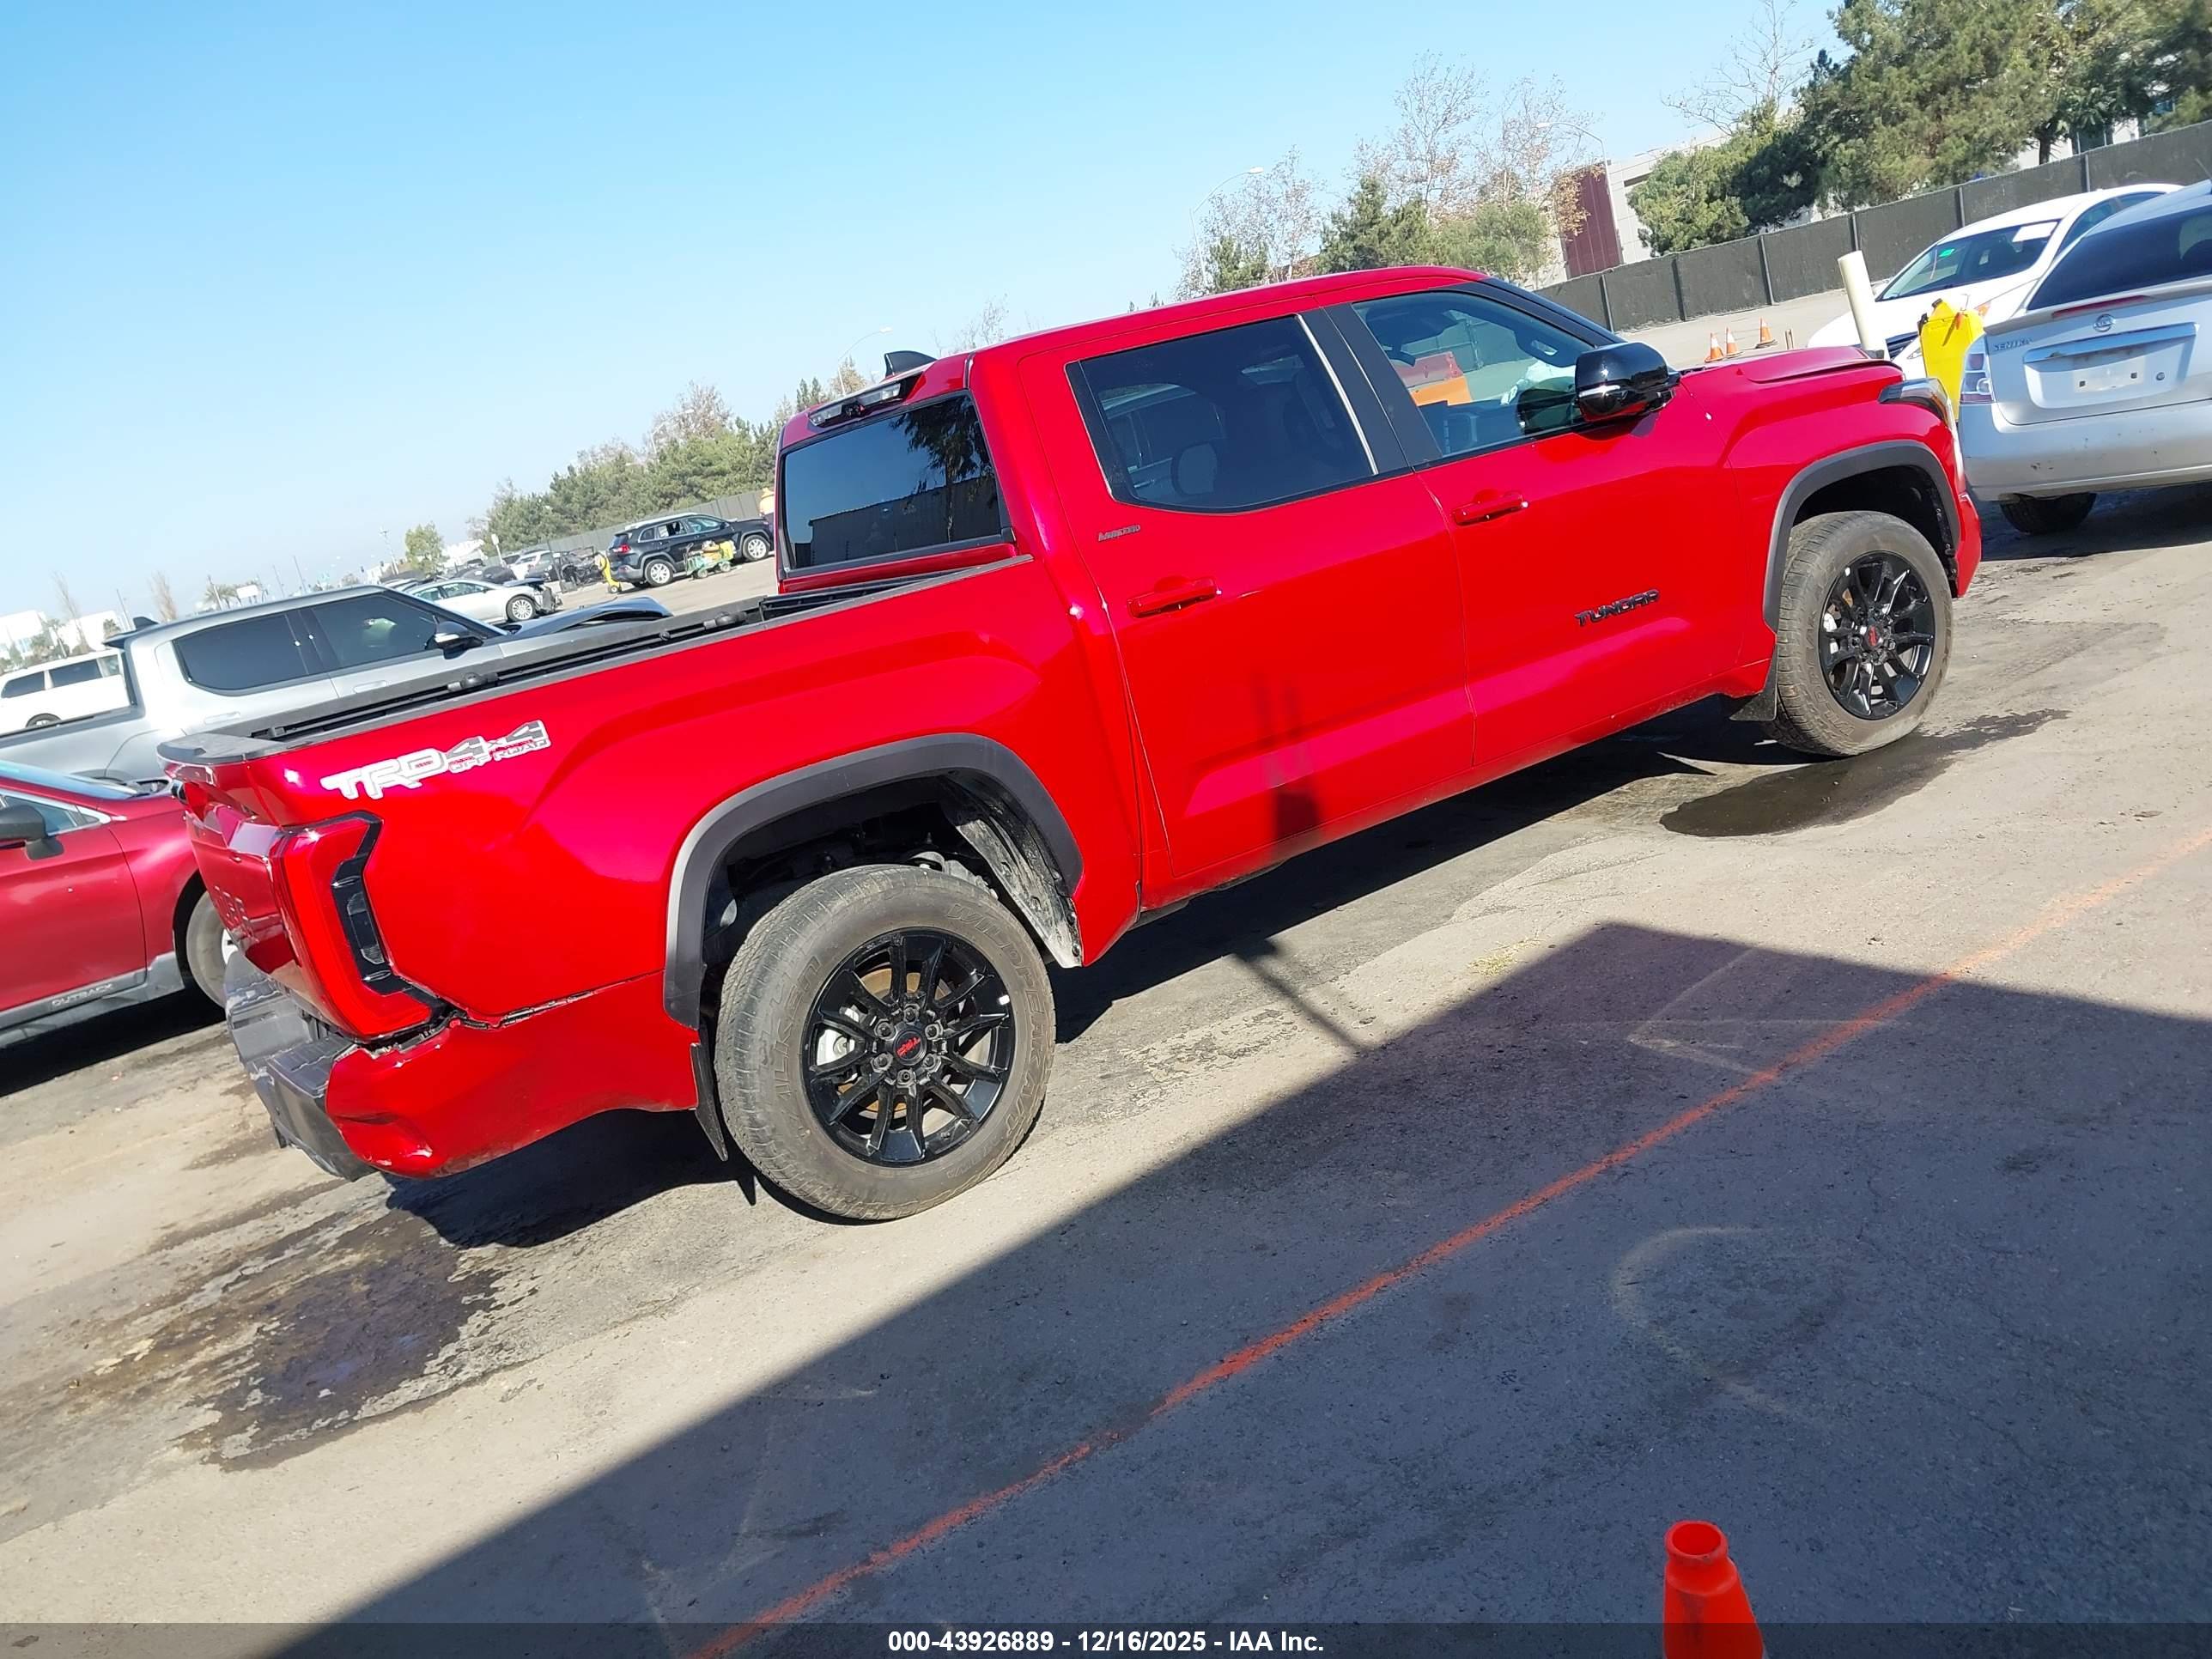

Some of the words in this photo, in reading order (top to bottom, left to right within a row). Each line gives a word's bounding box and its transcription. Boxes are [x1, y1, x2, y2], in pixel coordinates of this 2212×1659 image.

[1574, 588, 1659, 627] TUNDRA
[319, 748, 448, 799] TRD
[448, 754, 494, 774] OFF
[493, 738, 551, 762] ROAD
